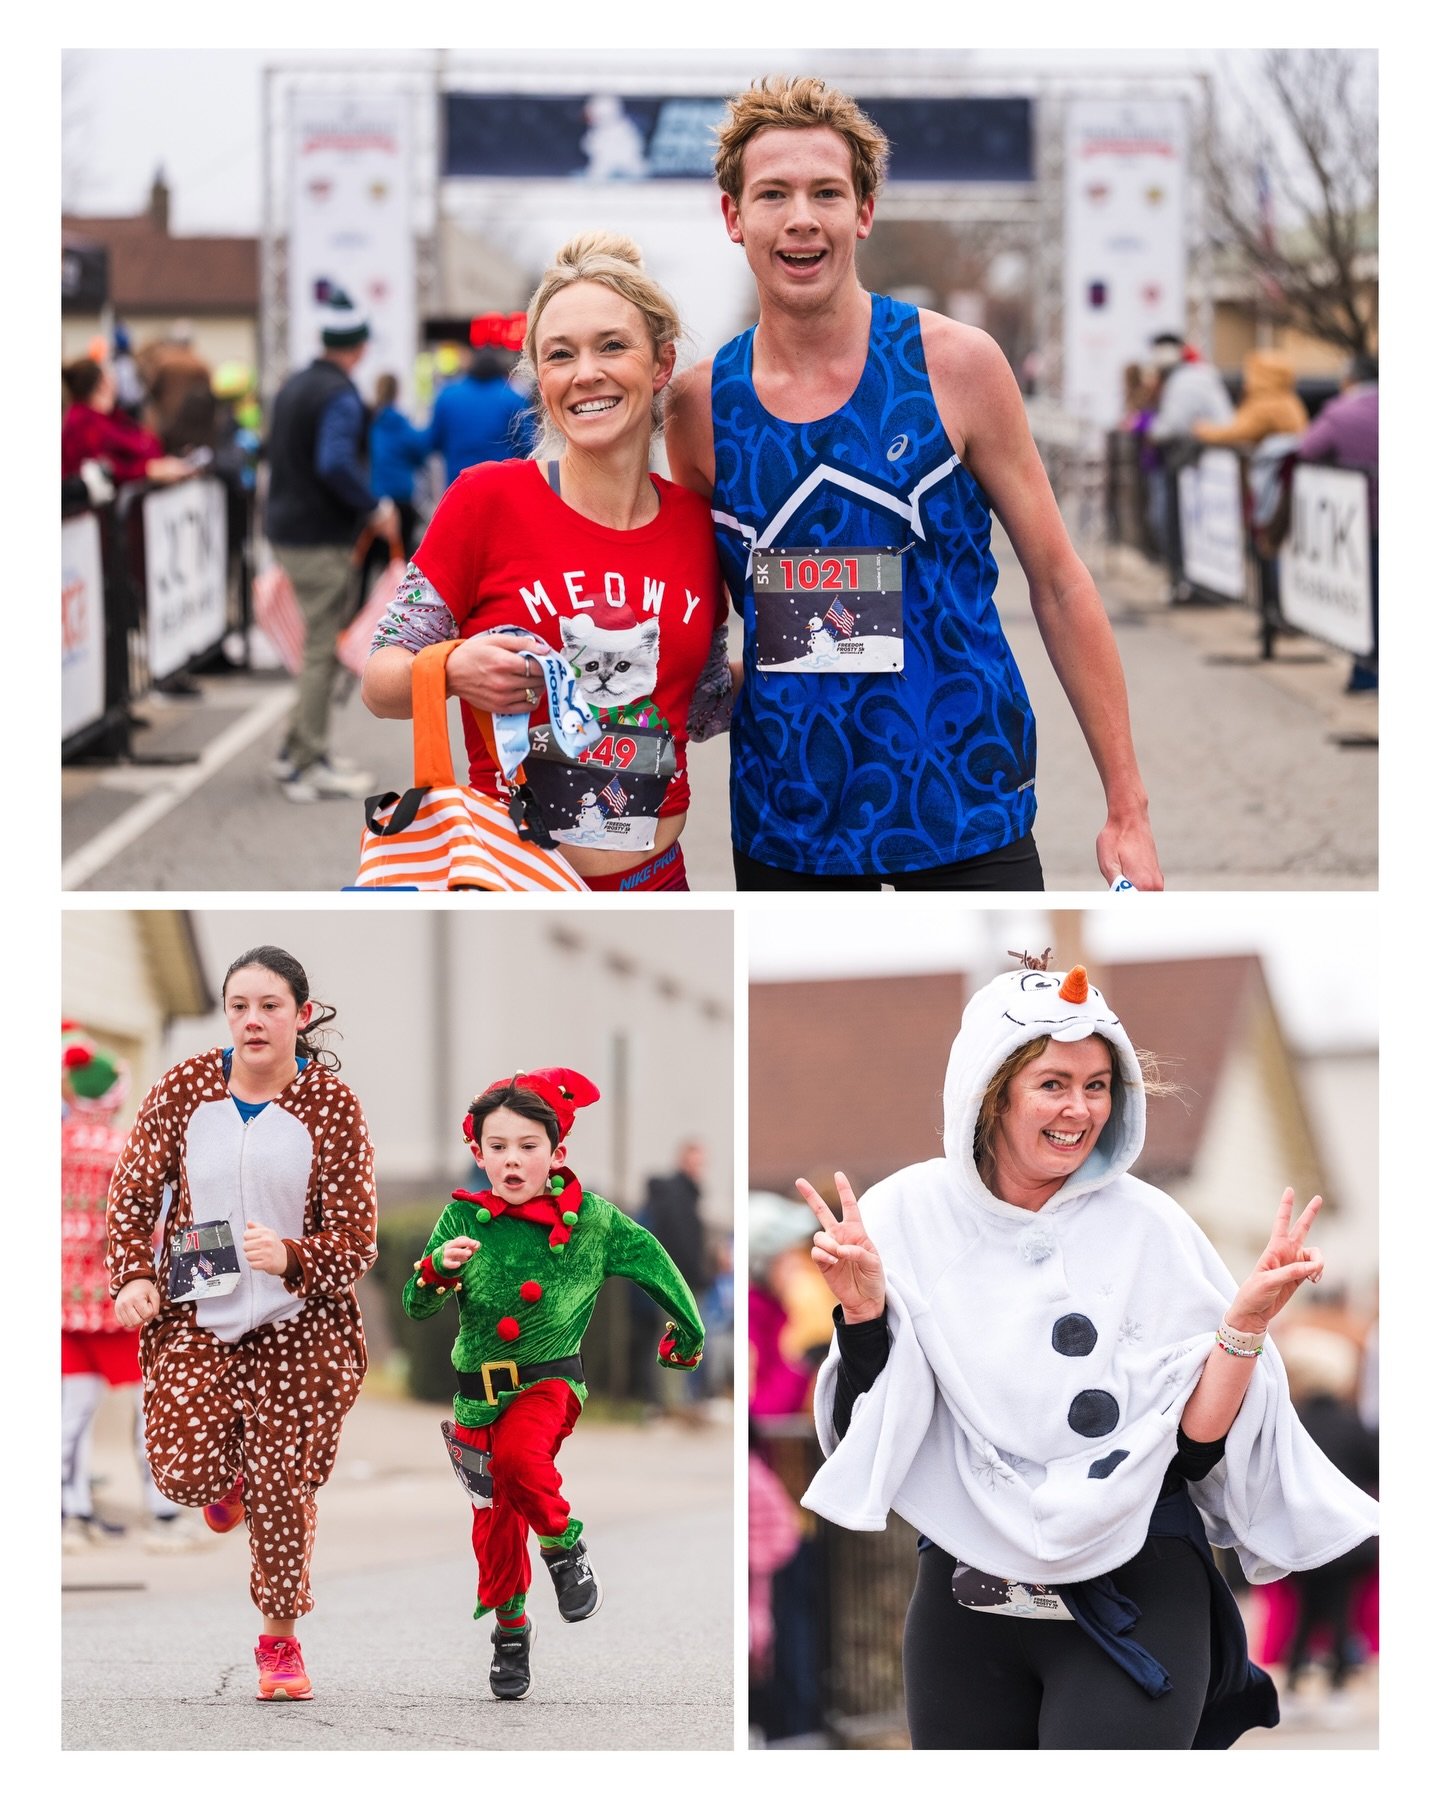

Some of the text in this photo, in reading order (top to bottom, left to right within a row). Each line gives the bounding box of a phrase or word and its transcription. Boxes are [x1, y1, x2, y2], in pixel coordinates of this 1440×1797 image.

[756, 563, 769, 585] 5K
[779, 558, 859, 591] 1021
[518, 570, 701, 625] MEOWY
[532, 731, 550, 753] 5K
[619, 847, 677, 891] NIKE PRO
[172, 1238, 181, 1252] 5K
[184, 1231, 199, 1253] 71
